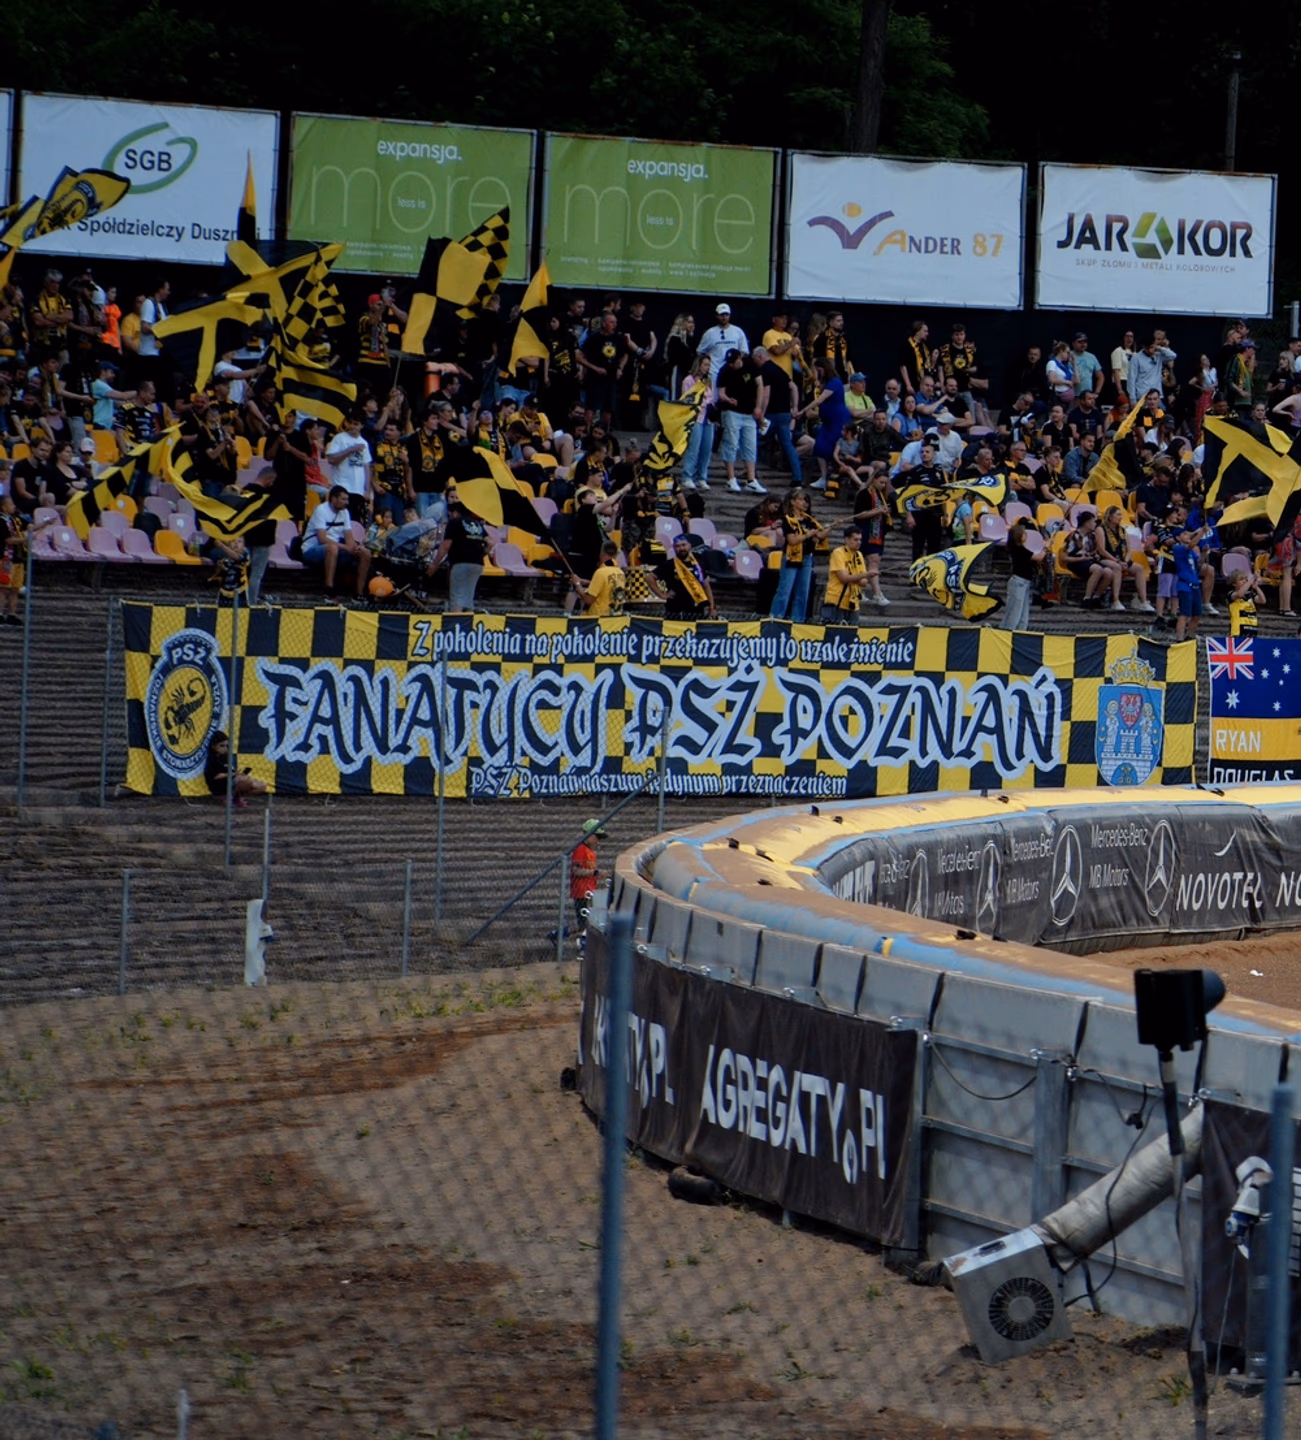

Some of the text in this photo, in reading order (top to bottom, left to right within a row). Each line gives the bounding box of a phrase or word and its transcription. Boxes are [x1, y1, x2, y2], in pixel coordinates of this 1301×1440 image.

[124, 149, 173, 172] SGB
[377, 140, 462, 164] expansja.
[627, 159, 709, 182] expansja.
[310, 165, 511, 234] more
[77, 217, 185, 242] Spółdzielczy
[191, 223, 261, 242] Duszni
[563, 184, 755, 254] more
[972, 233, 1003, 259] 87
[1075, 258, 1097, 267] SKUP
[1101, 259, 1132, 269] ZŁOMU
[1141, 261, 1173, 271] METALI
[1176, 263, 1236, 273] KOLOROWYCH
[171, 643, 208, 666] PSŻ
[411, 621, 914, 666] Z pokolenia na pokolenie przekazujemy to uzależnienie
[621, 657, 767, 767] PSŻ
[776, 667, 1061, 780] POZNAŃ
[1215, 730, 1261, 752] RYAN
[469, 762, 515, 795] PSŻ
[518, 765, 580, 795] Poznań
[722, 772, 847, 797] przeznaczeniem
[1089, 823, 1148, 850] Mercedes-Benz
[1088, 864, 1131, 889] MB Motors
[1016, 877, 1040, 902] Motors
[1175, 870, 1263, 911] NOVOTEL
